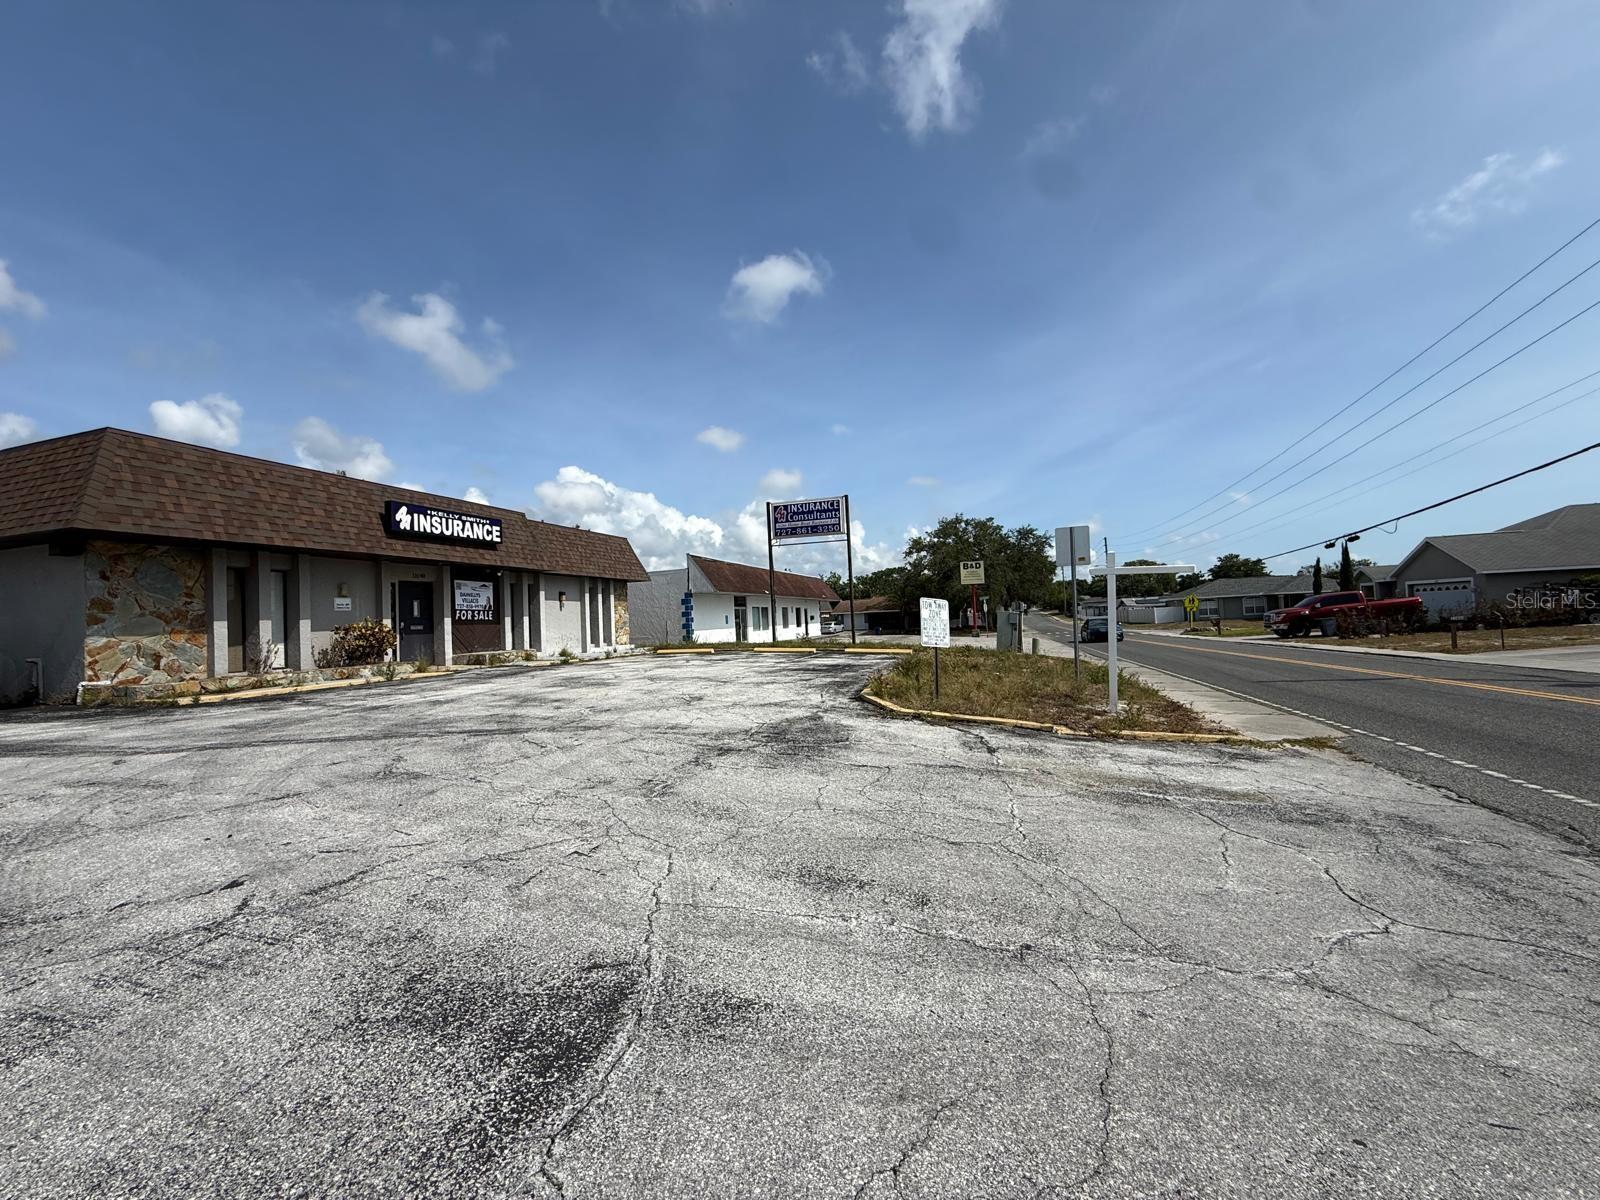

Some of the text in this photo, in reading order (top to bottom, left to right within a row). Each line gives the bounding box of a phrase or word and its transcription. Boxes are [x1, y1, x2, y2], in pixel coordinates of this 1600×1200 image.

[787, 500, 840, 513] INSURANCE
[431, 510, 487, 524] KELLY SMITH
[787, 510, 840, 522] Consultants
[413, 512, 502, 543] INSURANCE
[775, 524, 840, 536] 727-861-3250
[455, 610, 493, 620] FOR SALE
